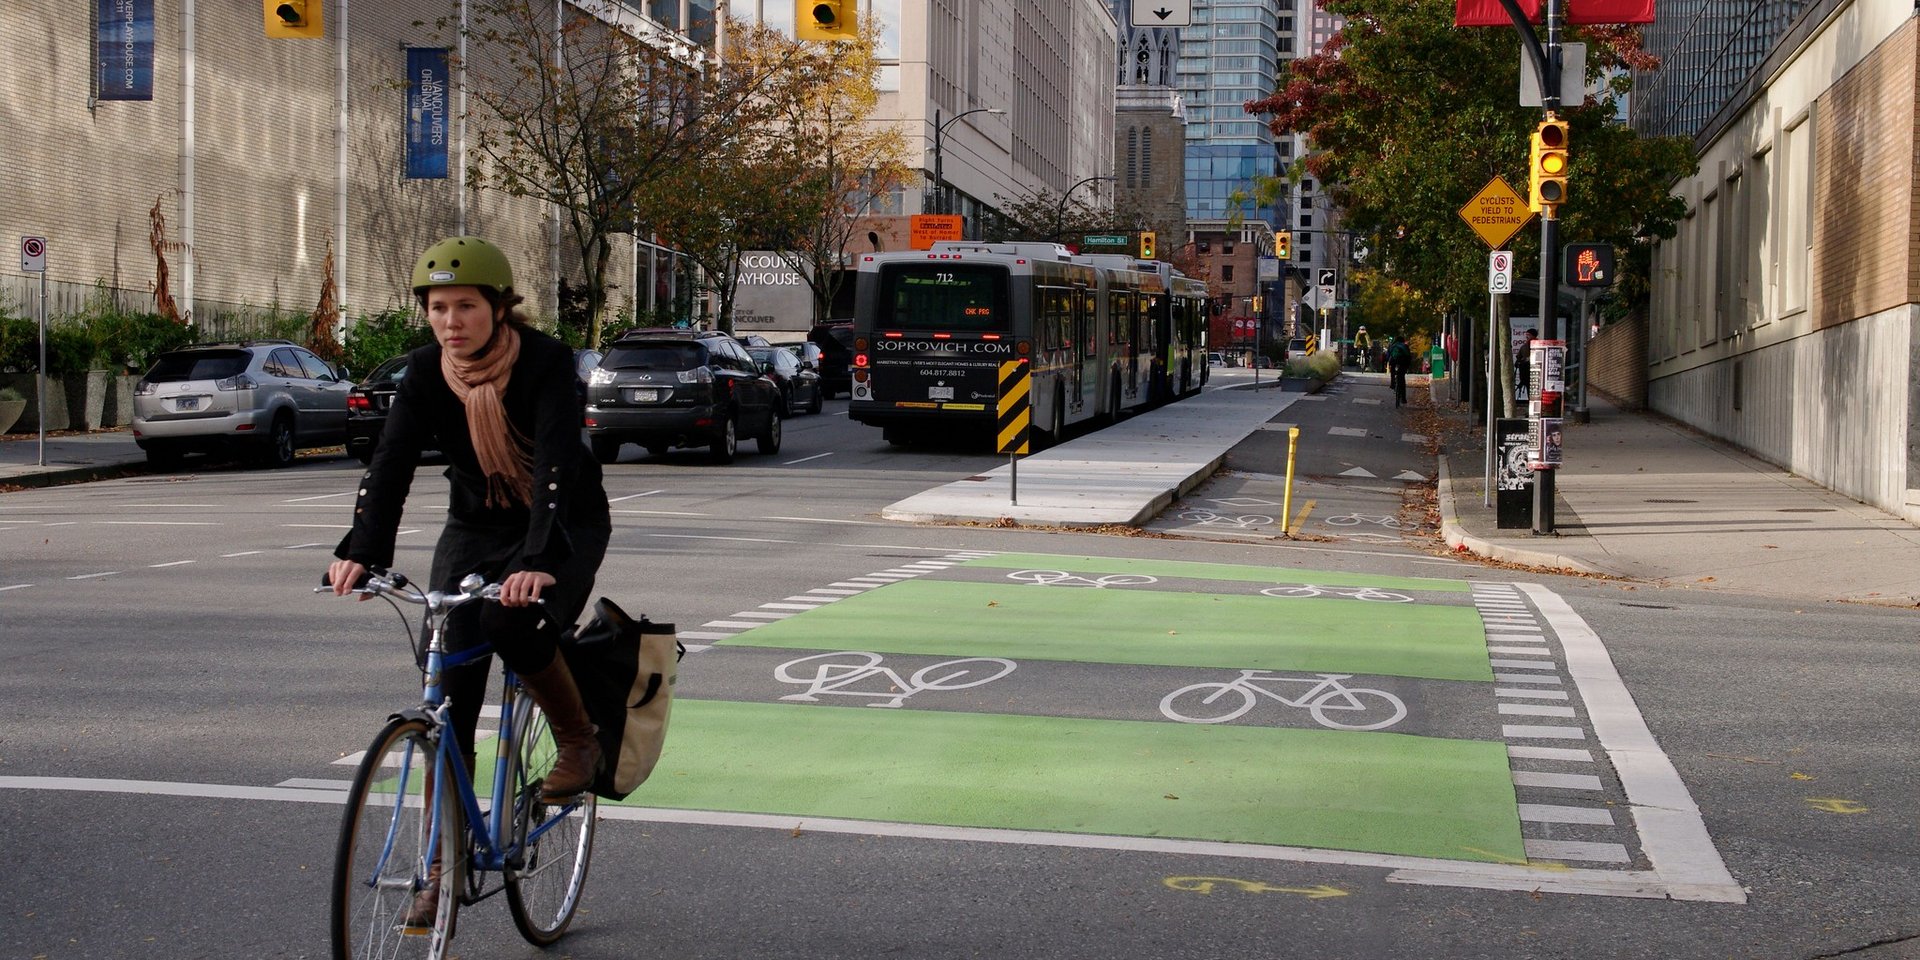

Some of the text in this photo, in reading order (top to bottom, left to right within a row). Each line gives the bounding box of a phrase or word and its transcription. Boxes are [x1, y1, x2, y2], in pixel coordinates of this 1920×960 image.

[125, 0, 134, 89] VERPLAYHOUSE.COM
[421, 68, 432, 113] ORIGINAL
[432, 80, 442, 145] VANCOUVER'S
[1480, 197, 1514, 205] CYCLISTS
[1481, 207, 1501, 215] YIELD
[1472, 216, 1521, 224] PEDESTRIANS
[739, 256, 803, 269] NCOUVER
[737, 272, 800, 285] AYHOUSE
[936, 273, 953, 282] 712
[965, 307, 990, 315] CHK PRG
[736, 315, 775, 323] NCOUVER
[920, 369, 965, 377] 604.817.8812
